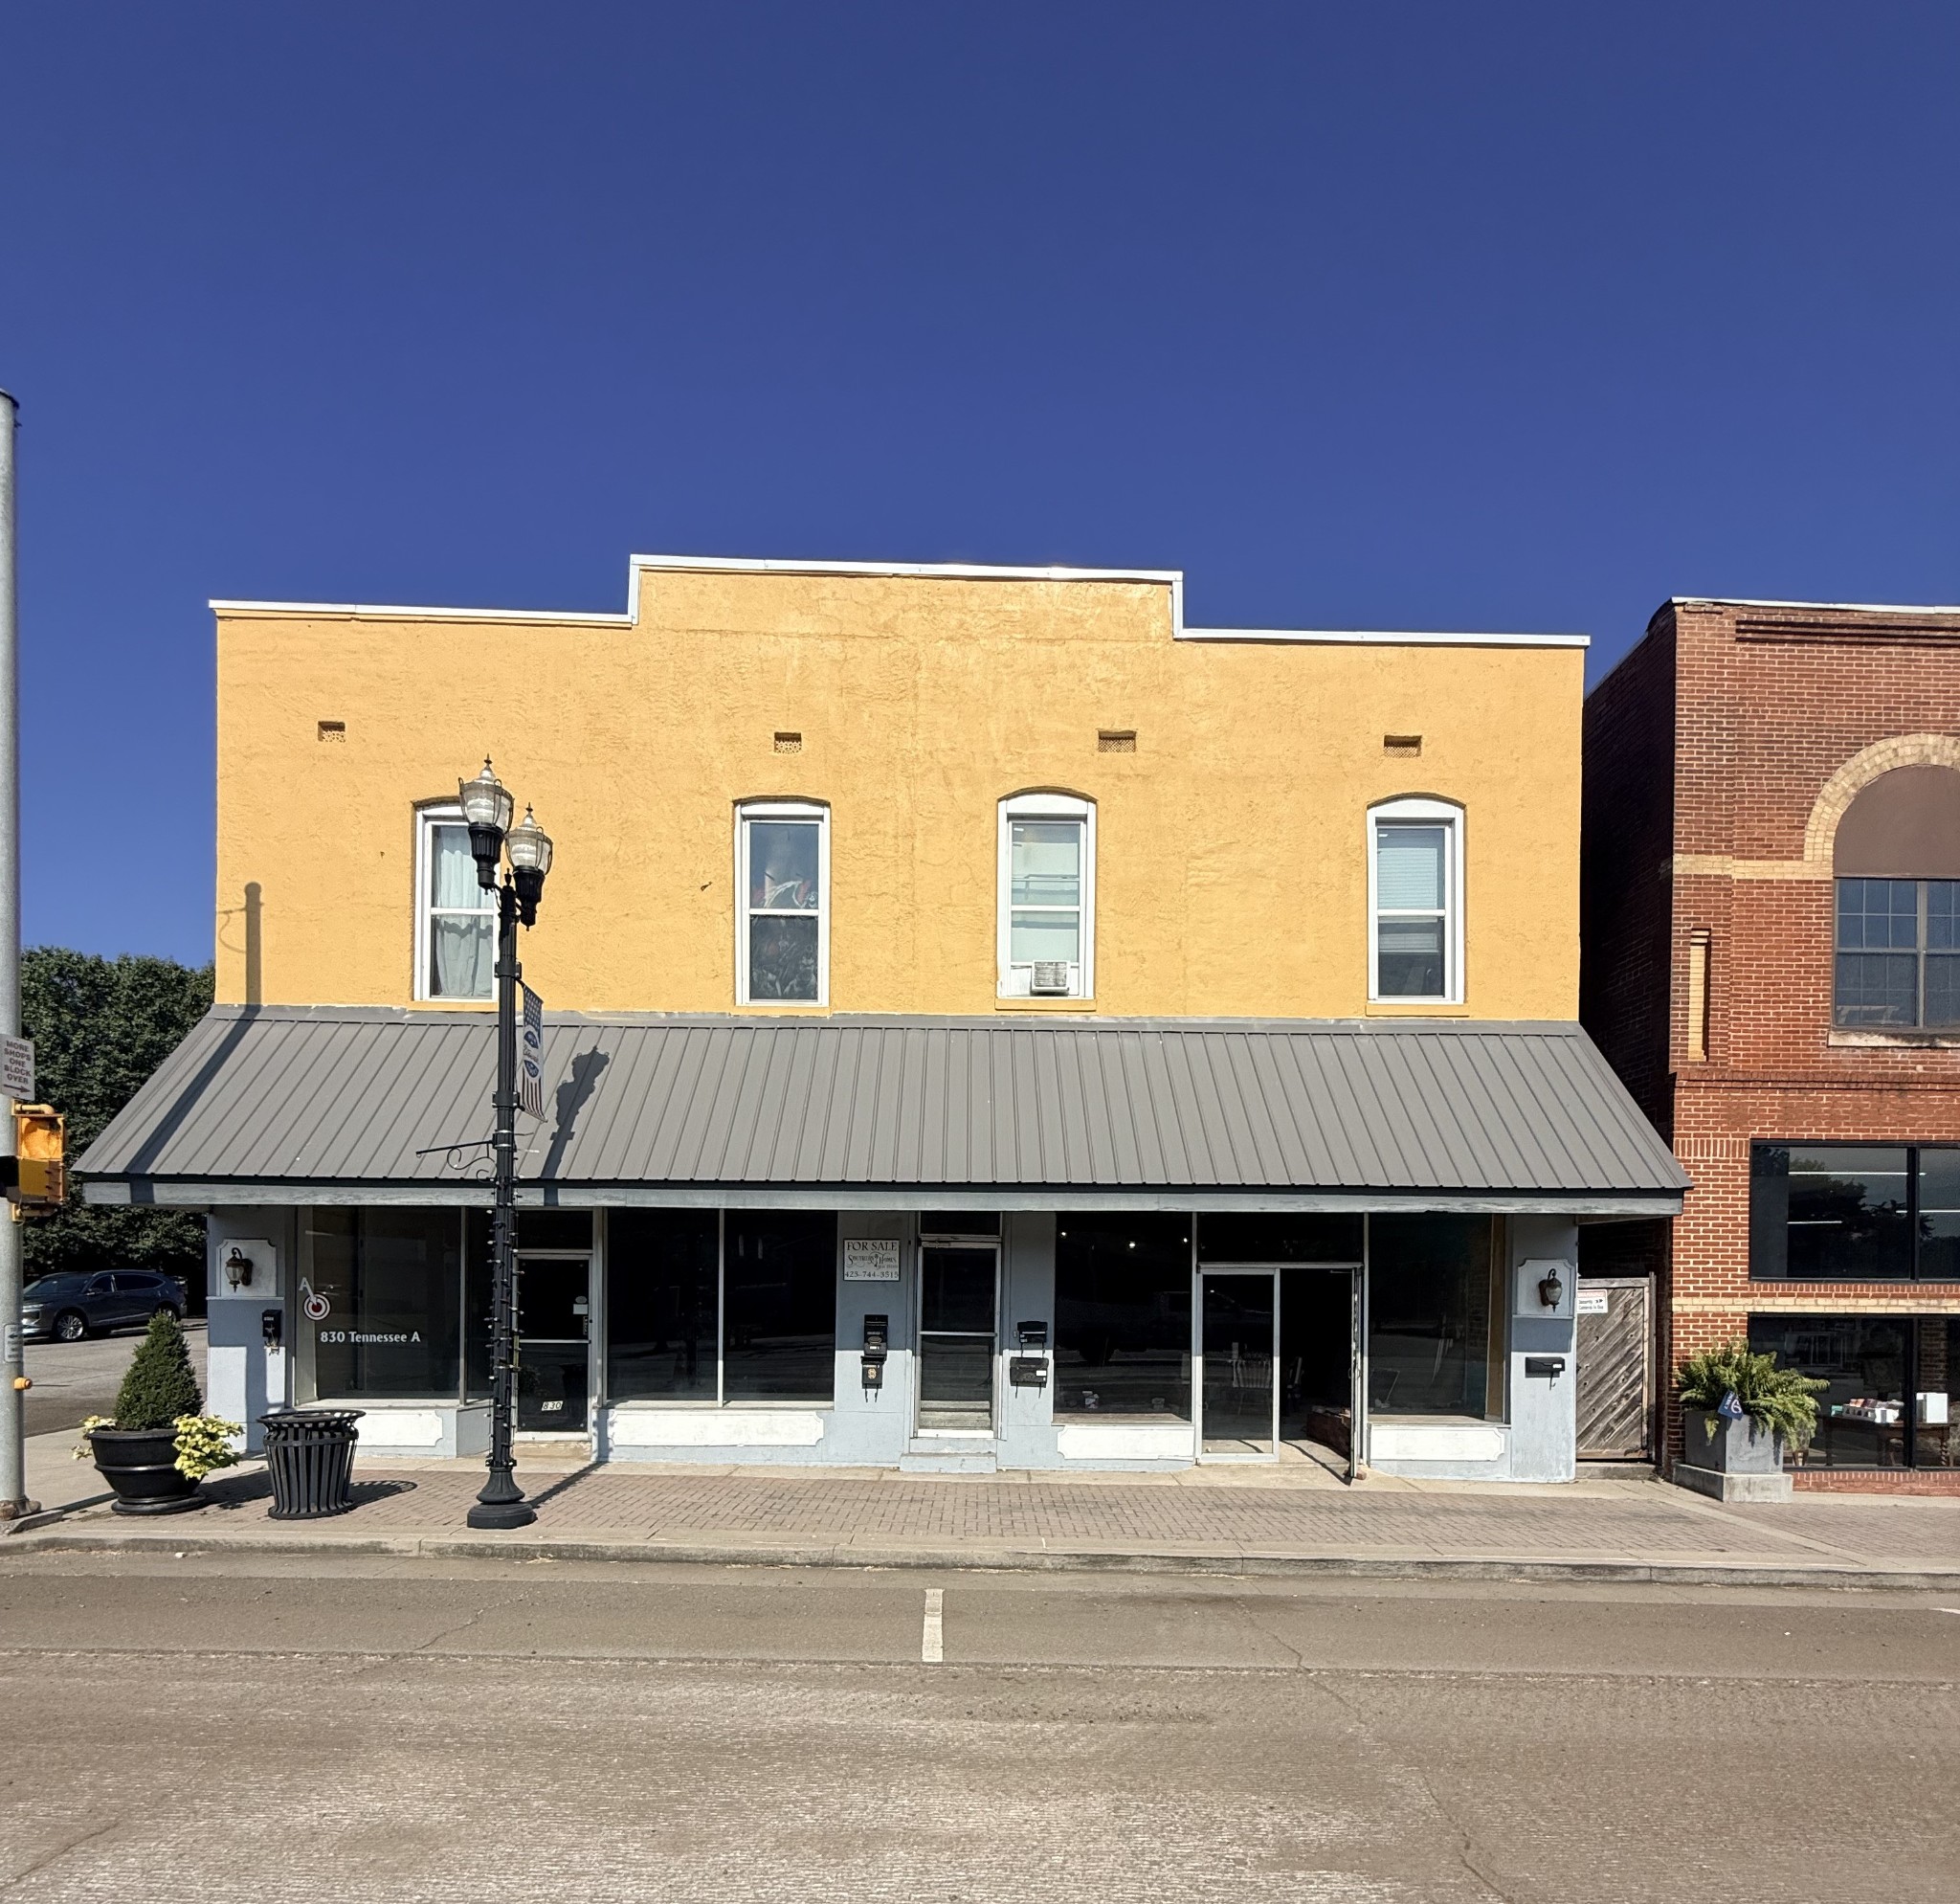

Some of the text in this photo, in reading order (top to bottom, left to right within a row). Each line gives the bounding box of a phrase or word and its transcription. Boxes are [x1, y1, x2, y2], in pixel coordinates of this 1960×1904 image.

[6, 1040, 29, 1052] MORE
[4, 1048, 32, 1061] SHOPS
[10, 1058, 26, 1067] ONE
[4, 1064, 31, 1077] BLOCK
[7, 1073, 29, 1085] OVER
[847, 1242, 897, 1251] FOR SALE
[321, 1332, 421, 1342] 830 Tennessee A
[543, 1401, 562, 1410] 830
